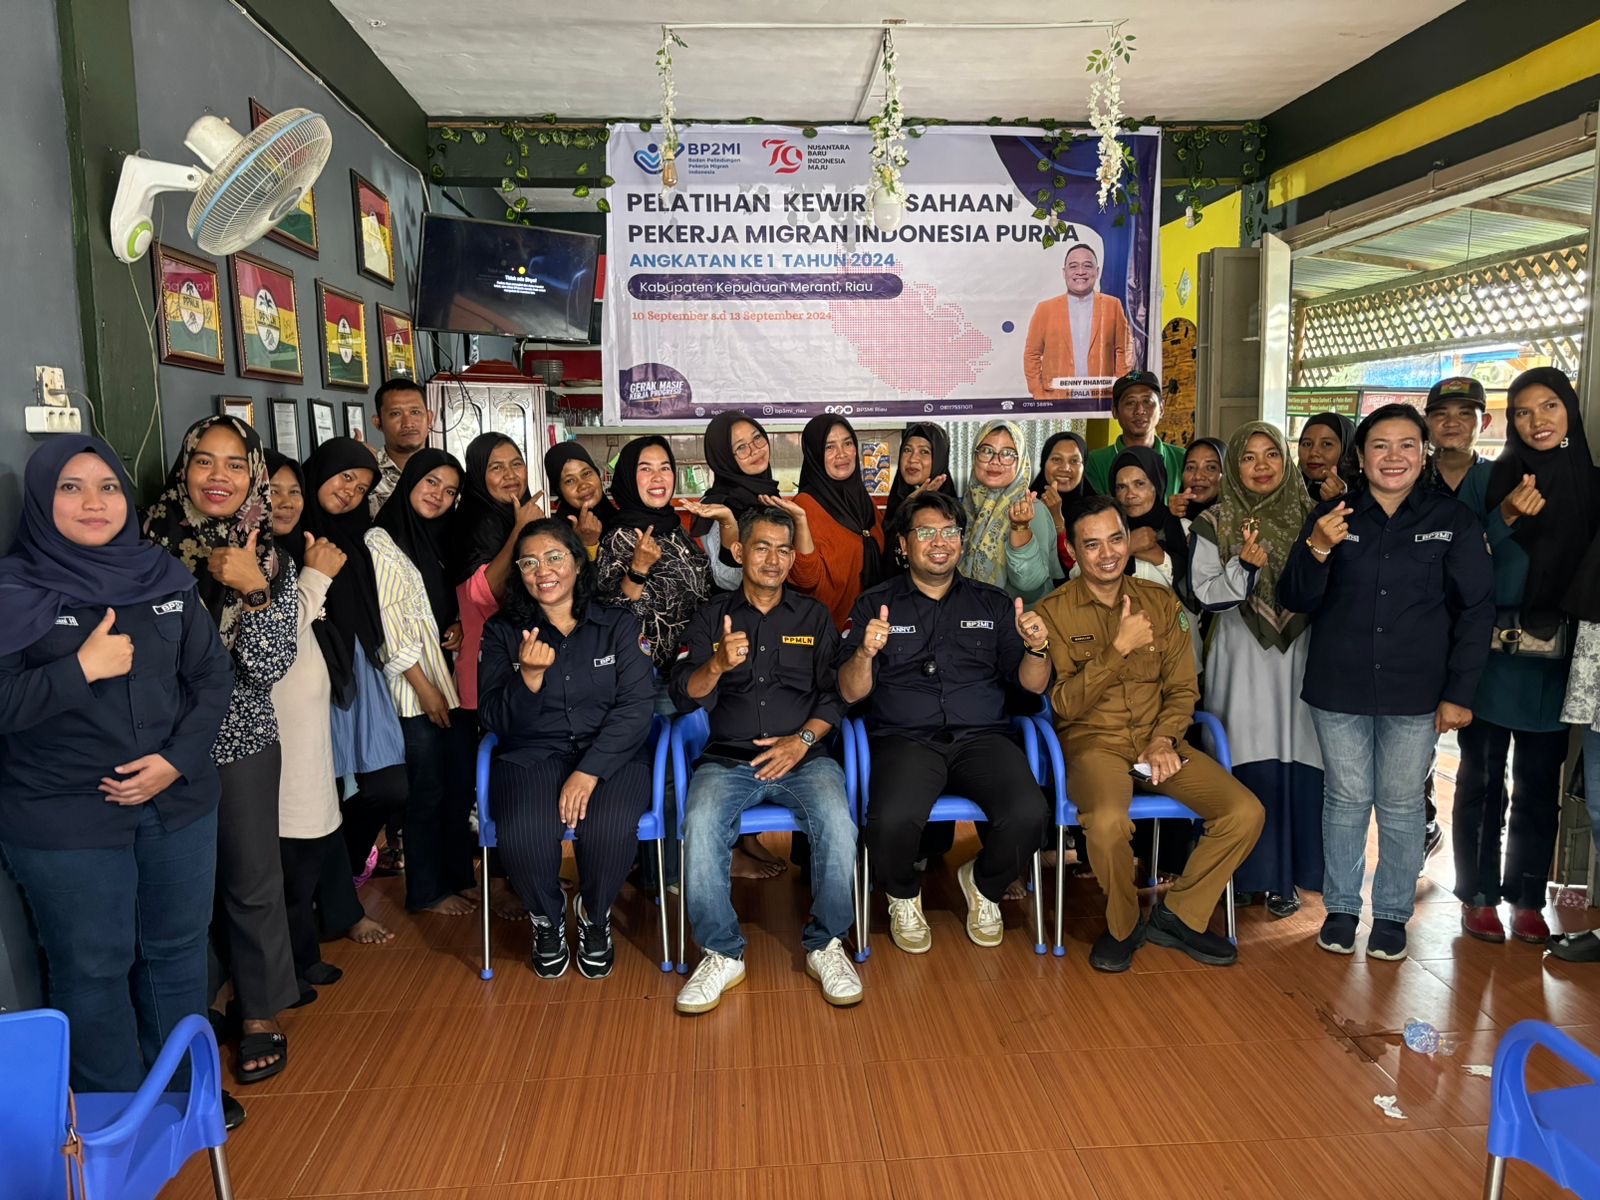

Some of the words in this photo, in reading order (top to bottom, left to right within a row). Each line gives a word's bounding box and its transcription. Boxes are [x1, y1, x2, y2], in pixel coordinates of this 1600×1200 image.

[688, 143, 741, 155] BP2MI
[627, 193, 770, 212] PELATIHAN
[784, 193, 1013, 212] KEWIRSAHAAN
[628, 224, 739, 243] PEKERJA
[745, 224, 848, 243] MIGRAN
[855, 224, 990, 243] INDONESIA
[629, 253, 736, 268] ANGKATAN
[741, 253, 763, 267] KE
[767, 253, 774, 267] 1
[782, 253, 847, 267] TAHUN
[851, 252, 895, 267] 2024
[639, 281, 713, 295] Kabupaten
[716, 281, 788, 295] Kepulauan
[790, 280, 843, 294] Meranti,
[846, 280, 873, 293] Riau
[632, 311, 645, 320] 10
[647, 311, 708, 322] September
[730, 311, 741, 320] 13
[743, 310, 804, 322] September
[806, 311, 833, 320] 2024
[629, 380, 657, 393] GERAK
[659, 380, 684, 390] MASIF
[783, 636, 813, 645] PPMLN
